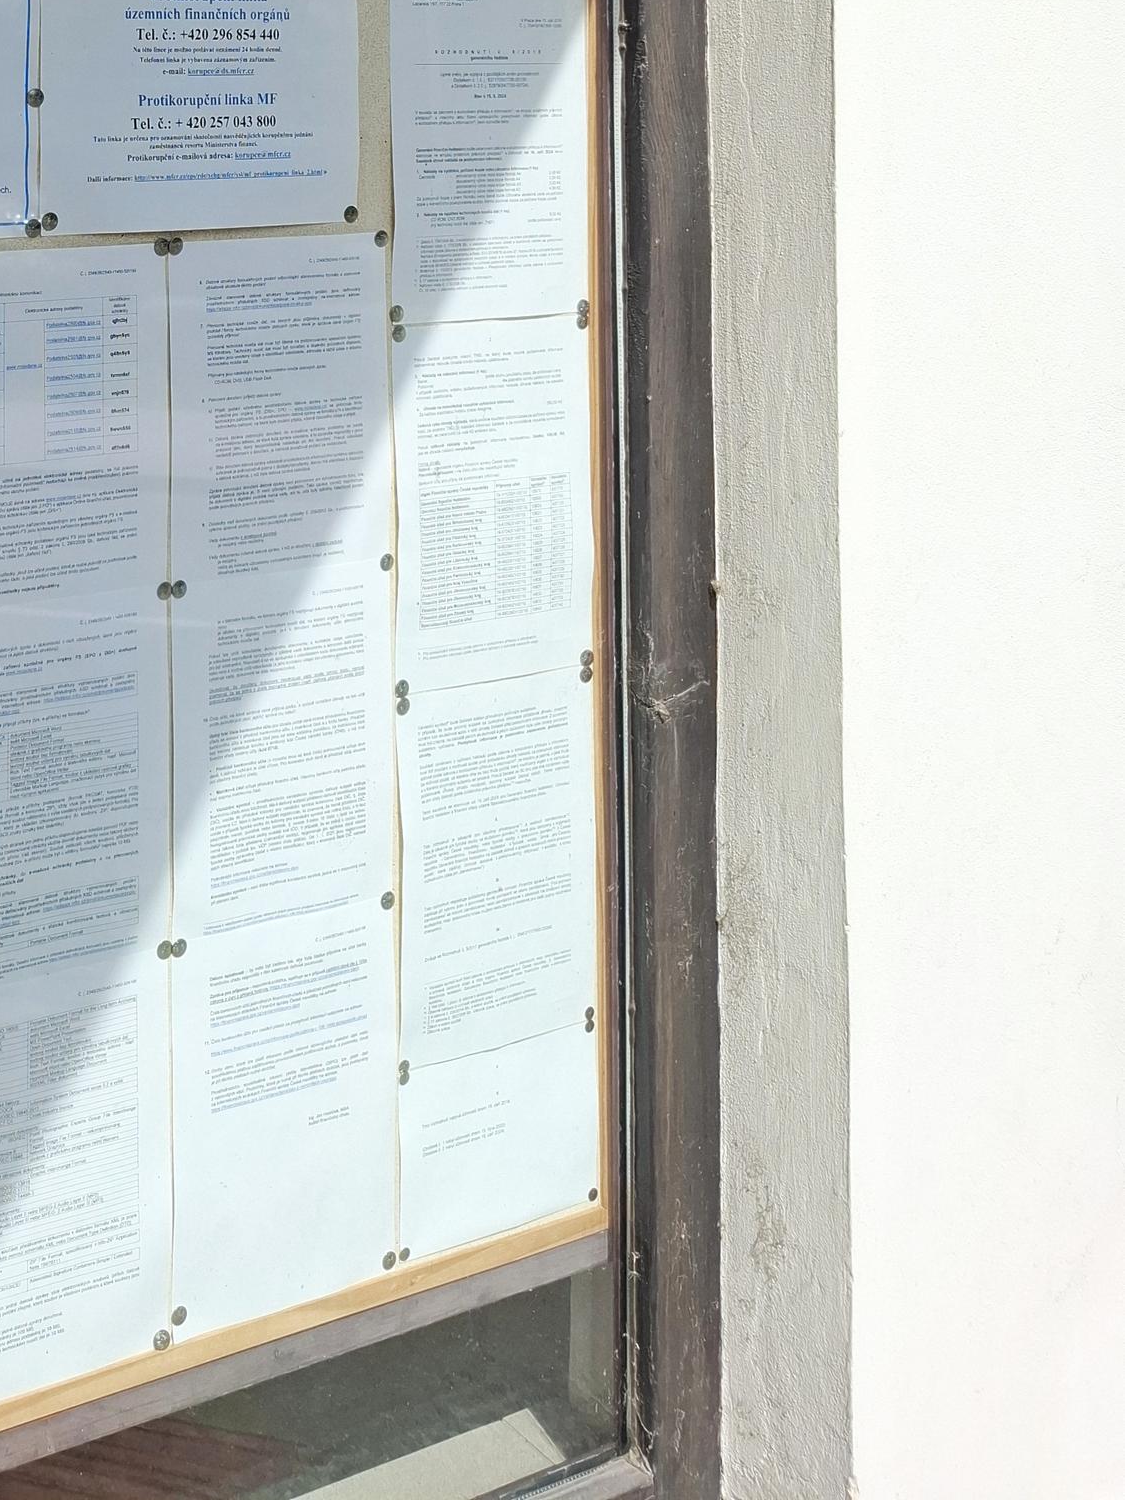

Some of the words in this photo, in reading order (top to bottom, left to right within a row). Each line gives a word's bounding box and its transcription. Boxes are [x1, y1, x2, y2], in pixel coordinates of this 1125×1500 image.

[125, 7, 180, 20] územních
[185, 8, 246, 20] finančních
[250, 8, 290, 23] orgánů
[136, 28, 158, 40] Tel.
[162, 28, 176, 40] č.:
[180, 29, 209, 40] +420
[212, 29, 232, 40] 296
[236, 29, 256, 41] 854
[260, 29, 279, 40] 440
[139, 93, 221, 108] Protikorupční
[225, 94, 253, 105] linka
[257, 93, 278, 105] MF
[131, 118, 153, 130] Tel.
[158, 117, 171, 130] č.:
[186, 116, 206, 129] 420
[210, 116, 229, 128] 257
[233, 115, 253, 128] 043
[256, 115, 276, 127] 800
[127, 154, 174, 162] Protikorupční
